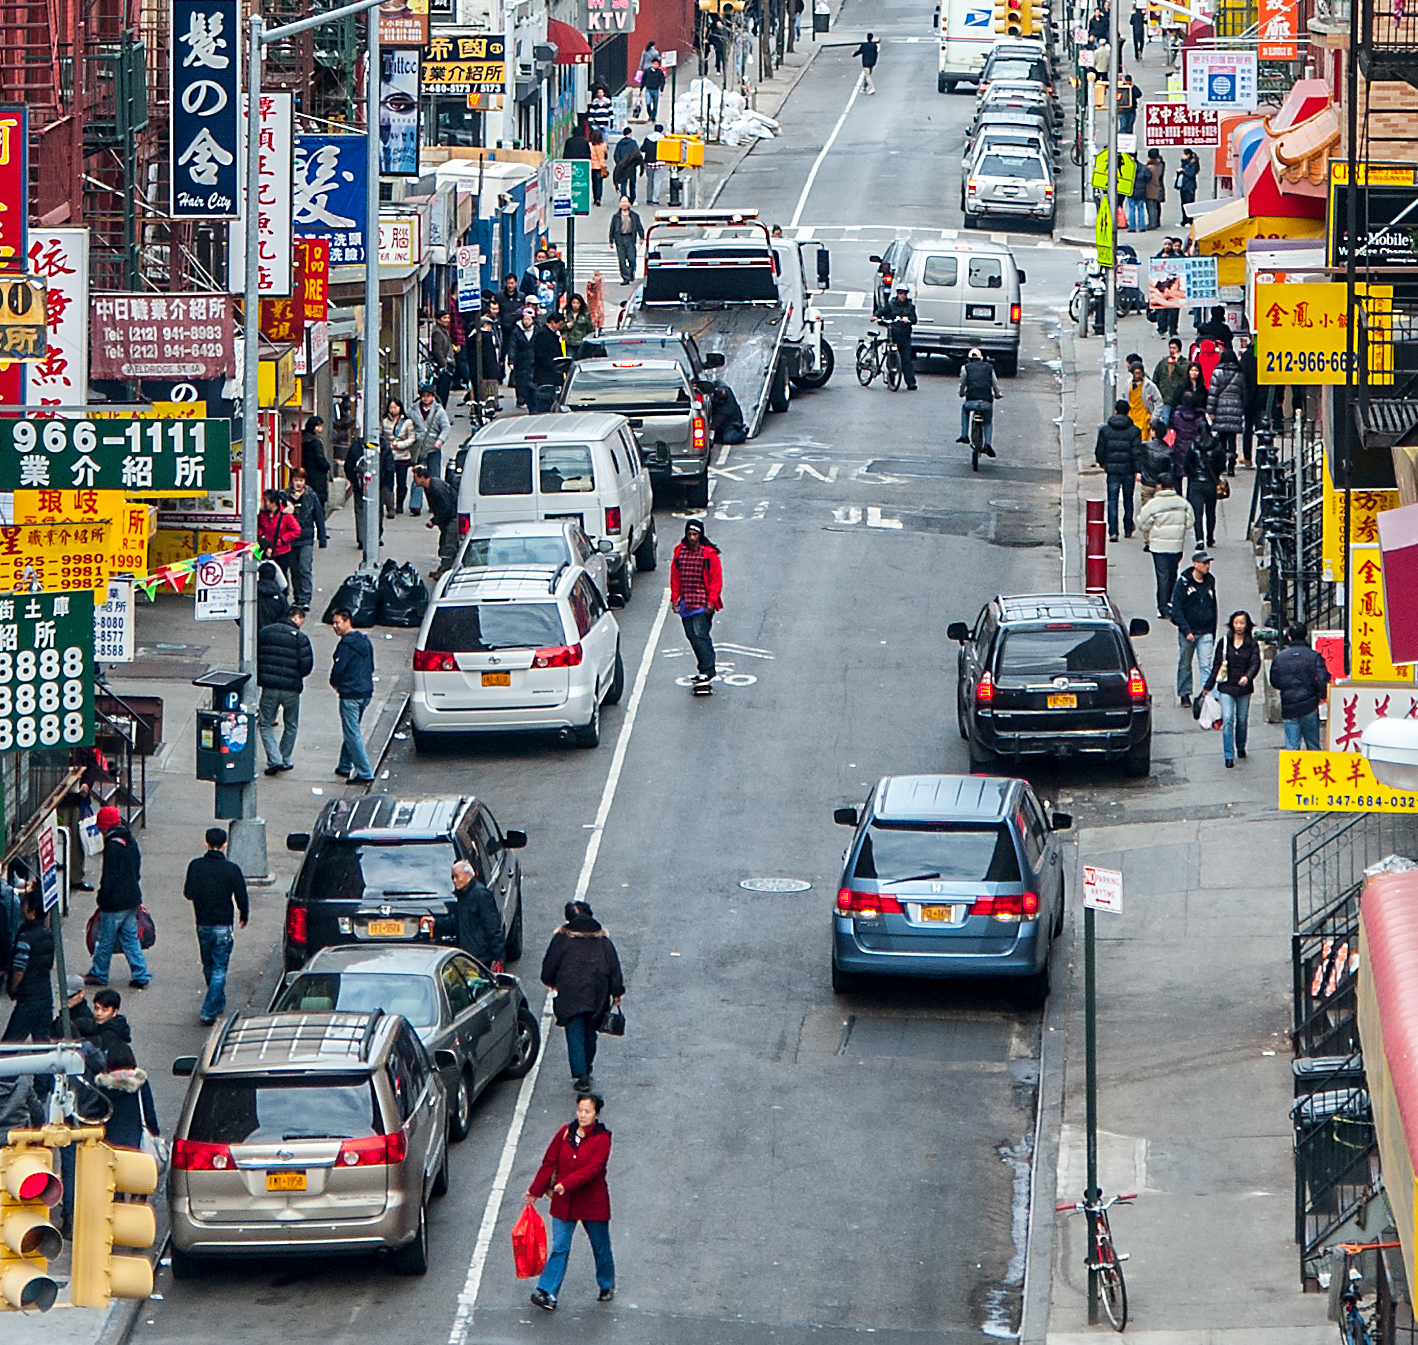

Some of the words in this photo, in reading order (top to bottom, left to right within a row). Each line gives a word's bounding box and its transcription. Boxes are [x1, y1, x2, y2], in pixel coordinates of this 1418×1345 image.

[588, 12, 627, 30] KTV
[425, 37, 487, 61] 帝國
[480, 84, 501, 92] 5173
[177, 191, 204, 208] Hair
[208, 191, 232, 211] City
[96, 298, 226, 321] 中日職業介紹所
[103, 327, 123, 341] Tel:
[129, 326, 157, 341] (212)
[163, 326, 222, 341] 941-8983
[104, 345, 123, 359] Tel:
[129, 344, 157, 359] (212)
[163, 343, 223, 358] 941-6429
[13, 421, 207, 454] 966-1111
[28, 527, 105, 547] 職業介紹所
[1296, 794, 1319, 805] Tel:
